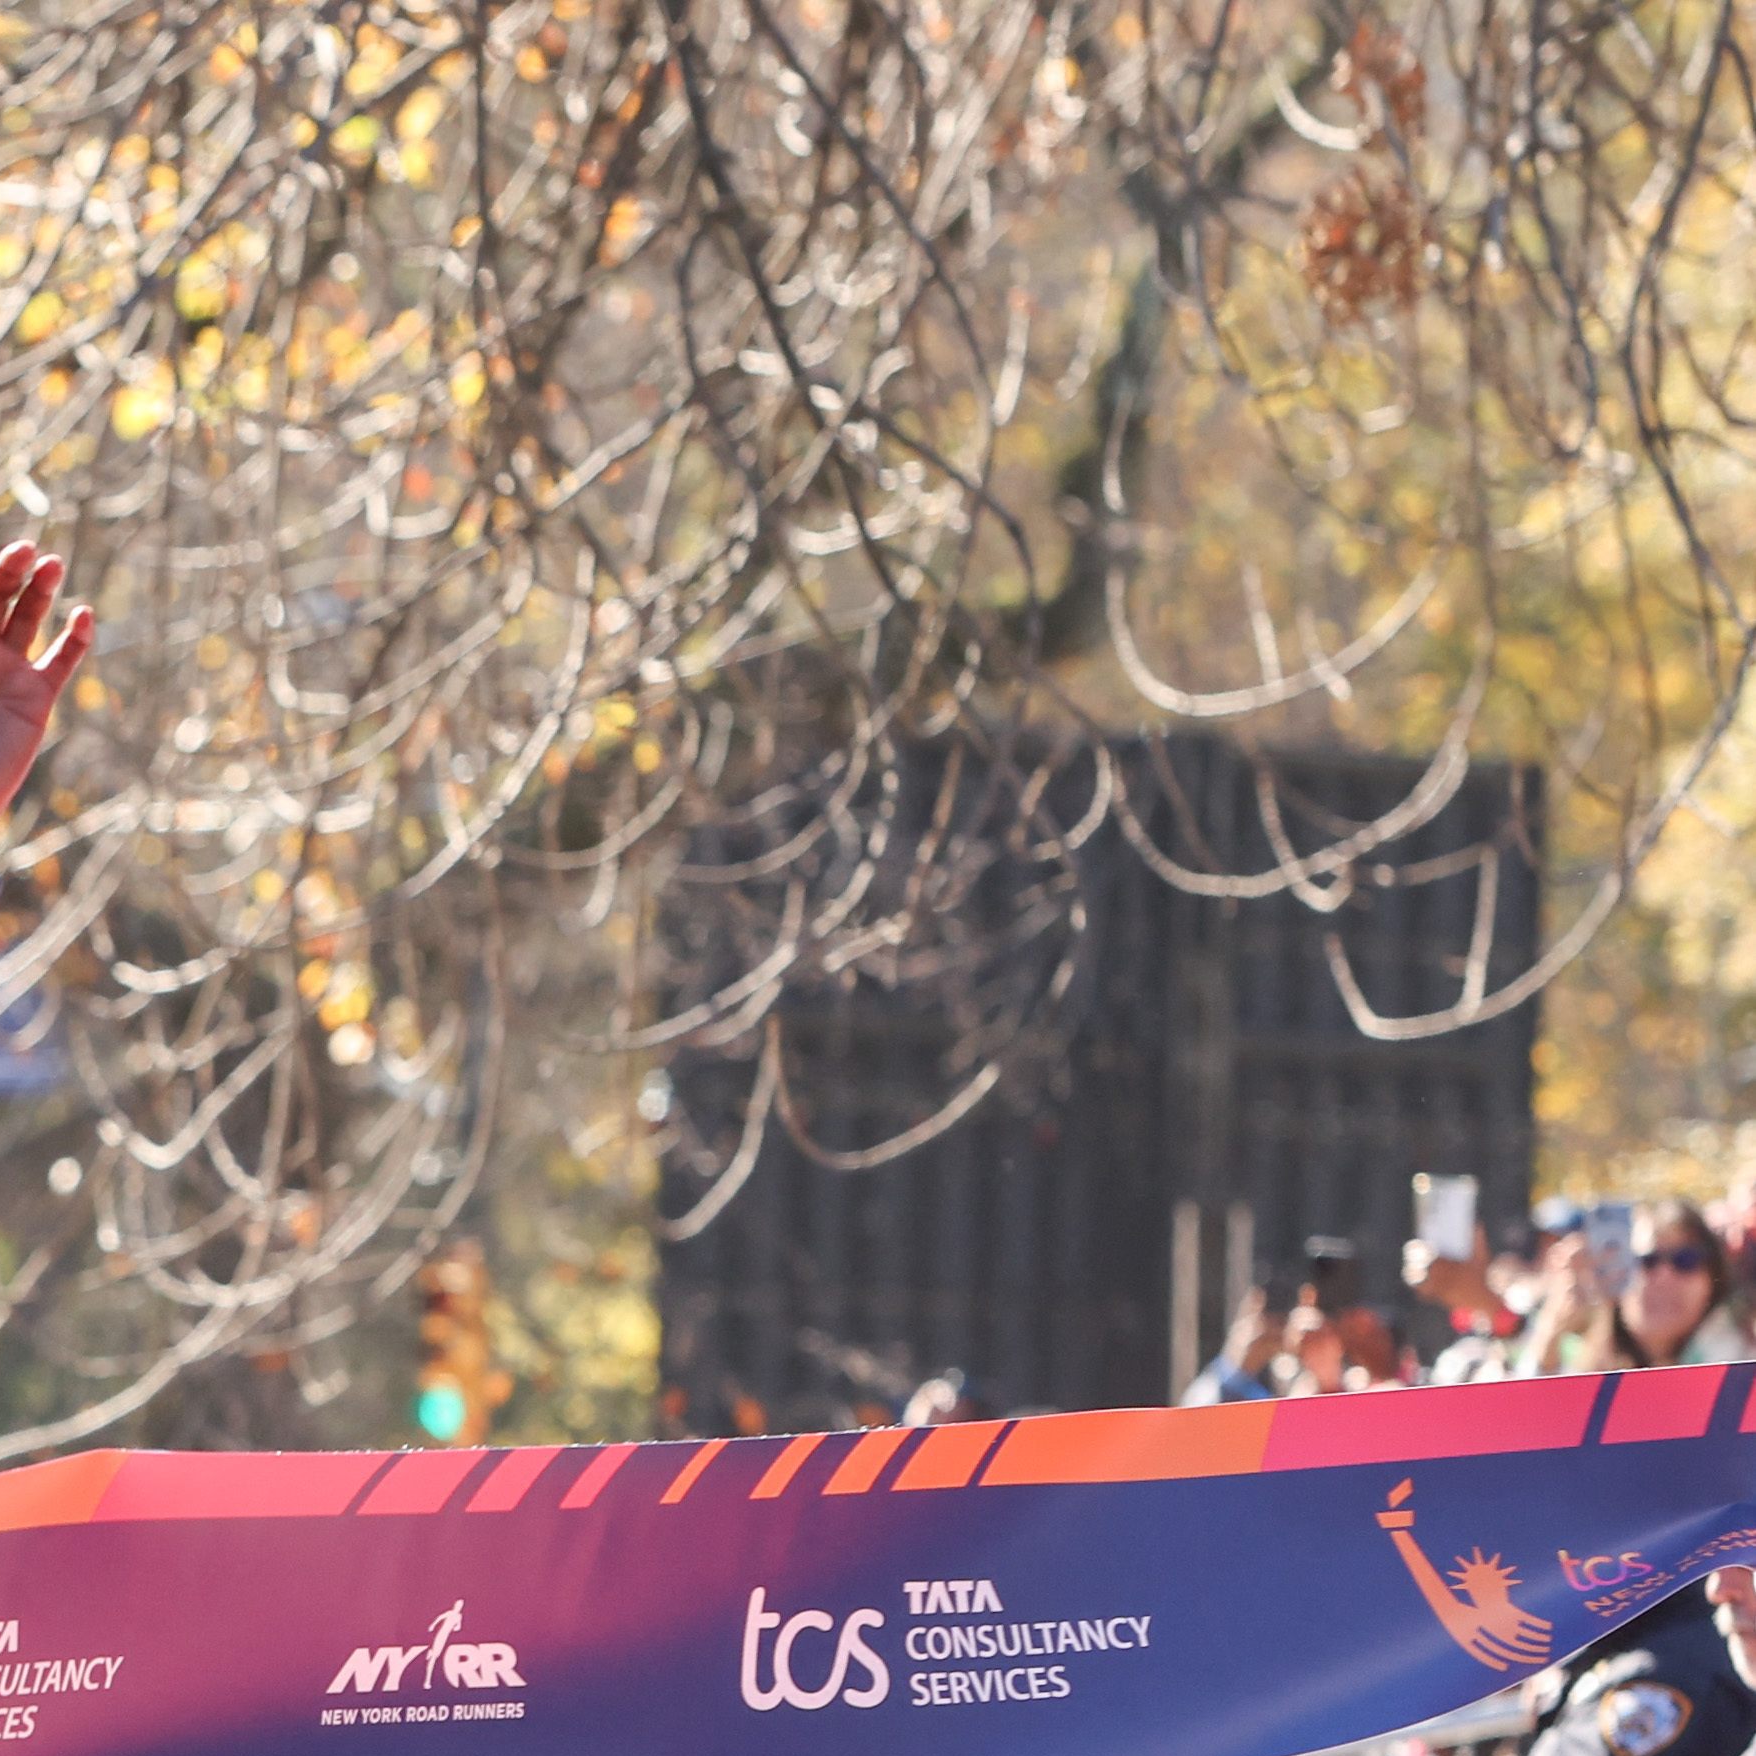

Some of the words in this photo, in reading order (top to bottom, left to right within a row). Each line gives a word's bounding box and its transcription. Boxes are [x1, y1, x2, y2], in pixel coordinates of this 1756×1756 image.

[1556, 1548, 1654, 1592] tcs
[903, 1580, 1004, 1615] TATA
[741, 1586, 890, 1711] tcs
[905, 1616, 1151, 1662] CONSULTANCY
[909, 1665, 1071, 1707] SERVICES
[321, 1709, 358, 1726] NEW
[361, 1706, 403, 1725] YORK
[405, 1704, 450, 1722] ROAD
[453, 1702, 526, 1721] RUNNERS
